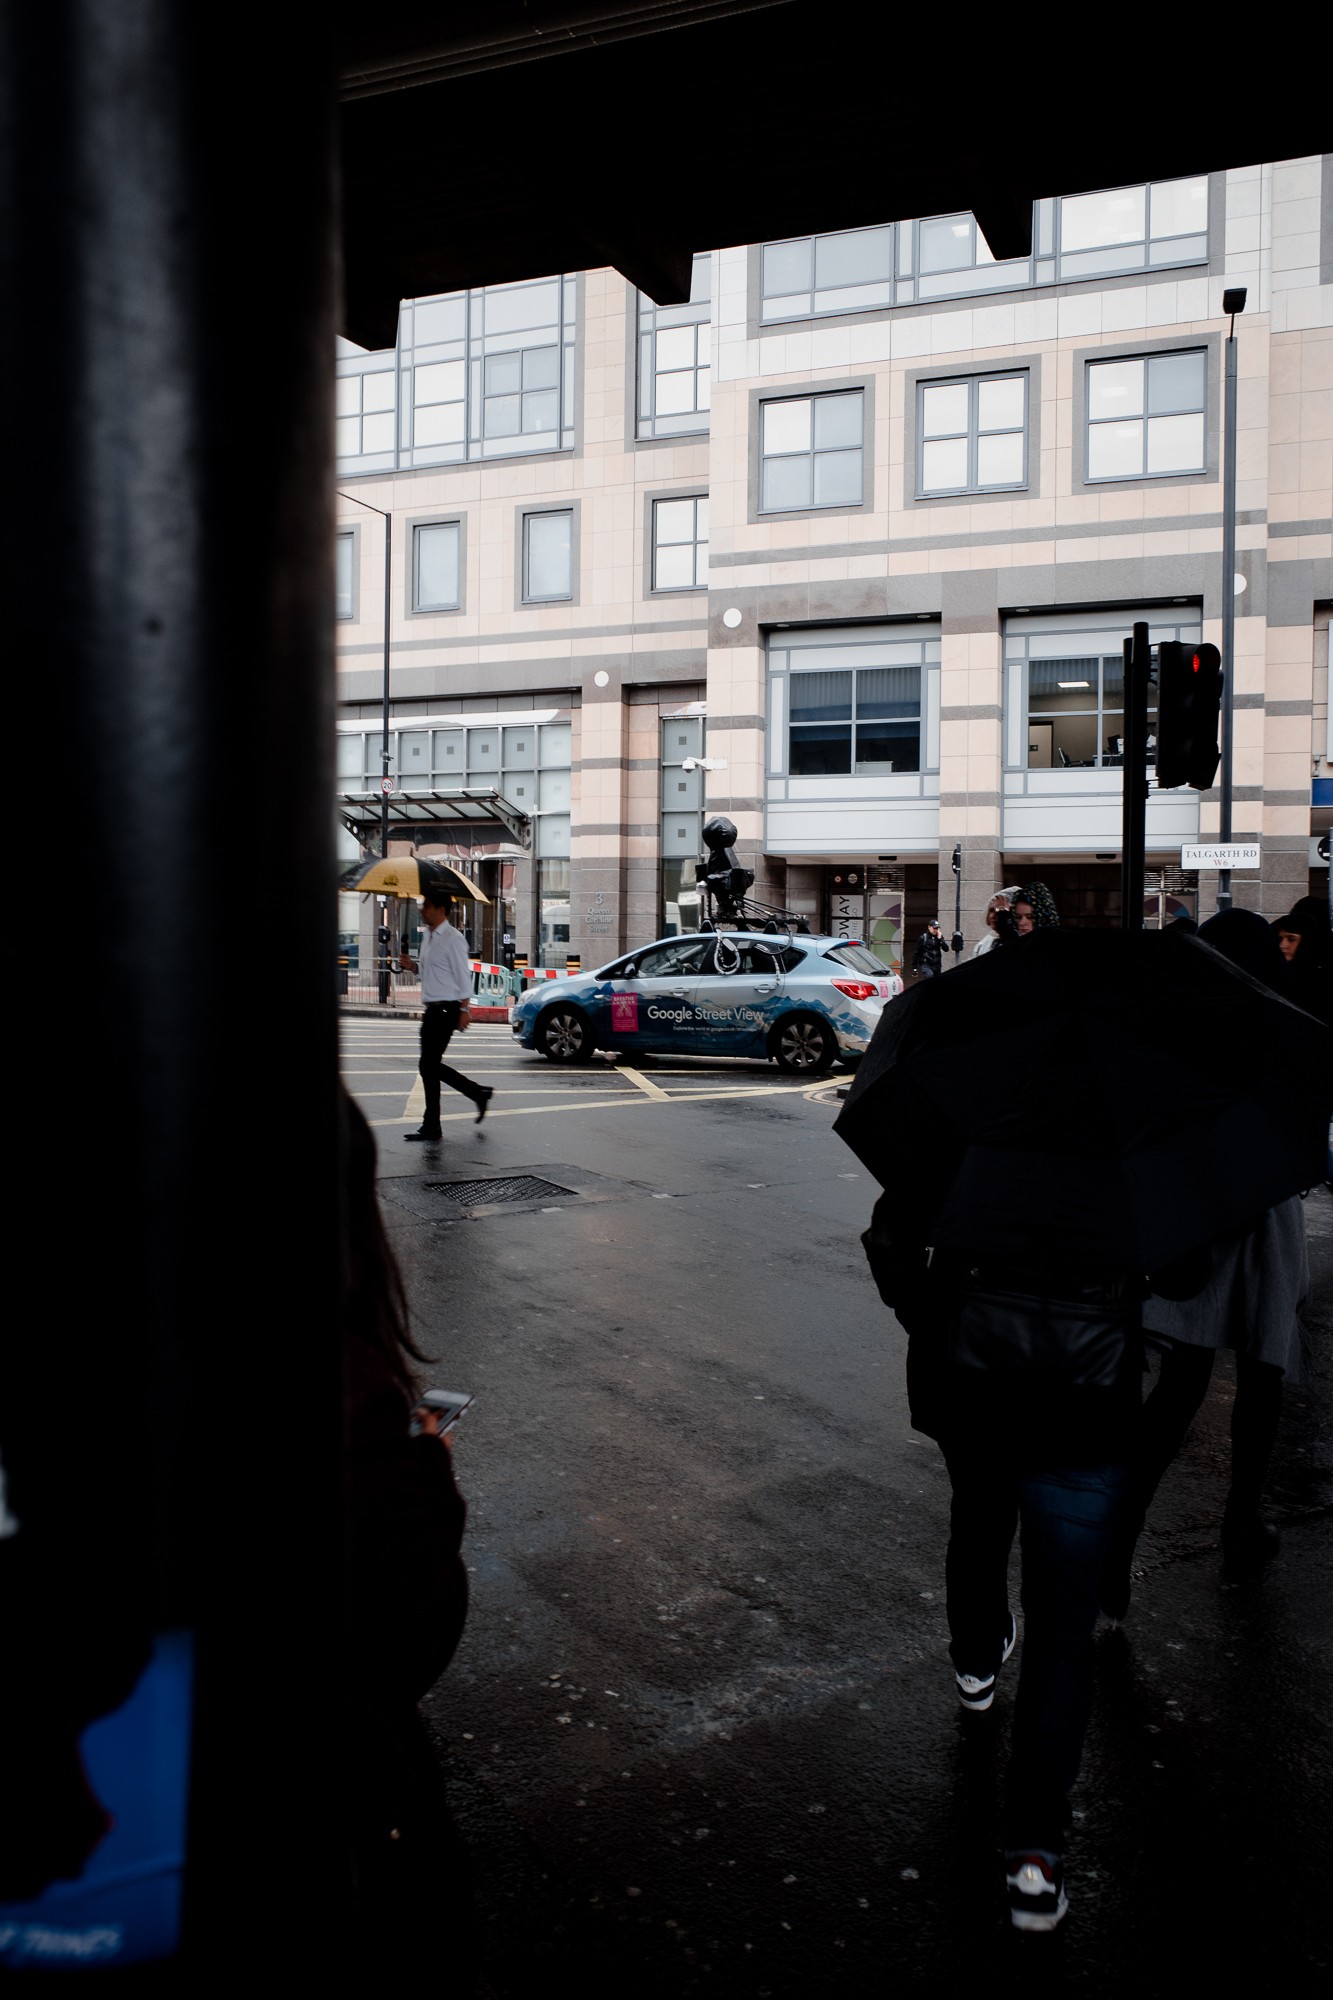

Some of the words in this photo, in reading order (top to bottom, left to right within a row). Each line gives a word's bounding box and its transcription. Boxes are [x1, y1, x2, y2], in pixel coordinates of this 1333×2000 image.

[1185, 850, 1240, 858] TALGARTH
[1243, 850, 1257, 858] RD
[1213, 859, 1229, 867] W6
[595, 892, 604, 905] 3
[647, 1005, 693, 1023] Google
[694, 1007, 731, 1020] Street
[733, 1008, 765, 1020] View
